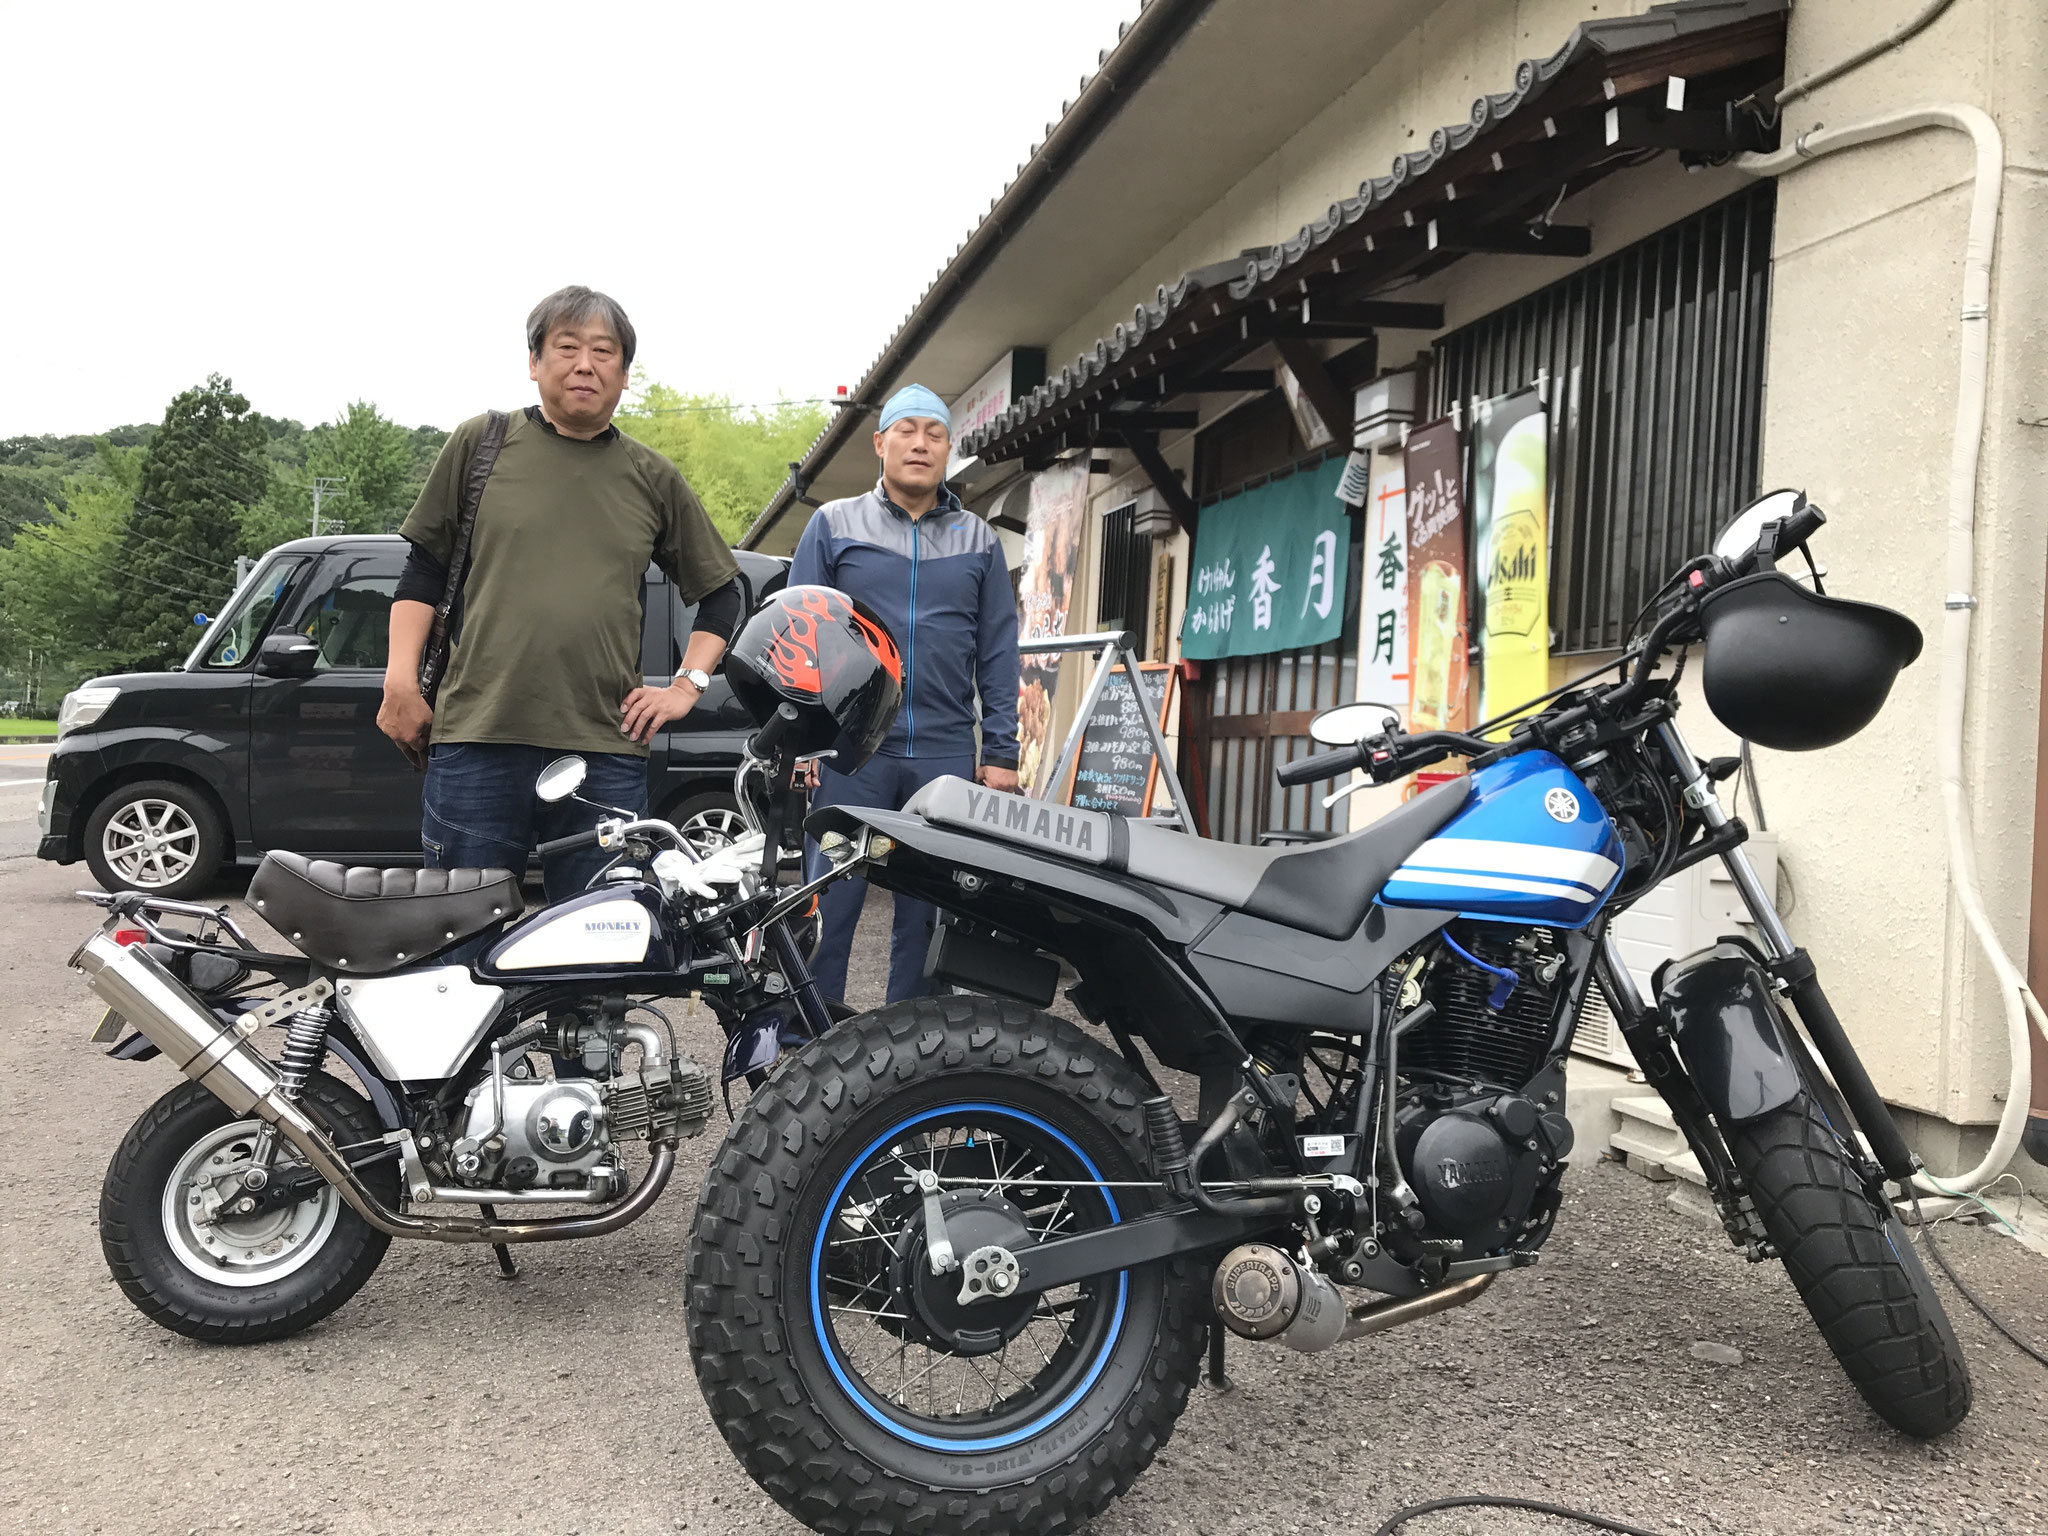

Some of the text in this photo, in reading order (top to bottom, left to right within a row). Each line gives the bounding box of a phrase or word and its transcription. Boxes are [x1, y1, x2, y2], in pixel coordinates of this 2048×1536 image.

[1248, 530, 1336, 631] 香月
[1487, 543, 1537, 589] Asahi
[1371, 531, 1404, 666] 香月
[967, 789, 1092, 851] YAMAHA
[585, 921, 641, 931] MONKEY
[1227, 1261, 1279, 1291] SUPERTRAPP
[1040, 1417, 1089, 1455] TRAIL
